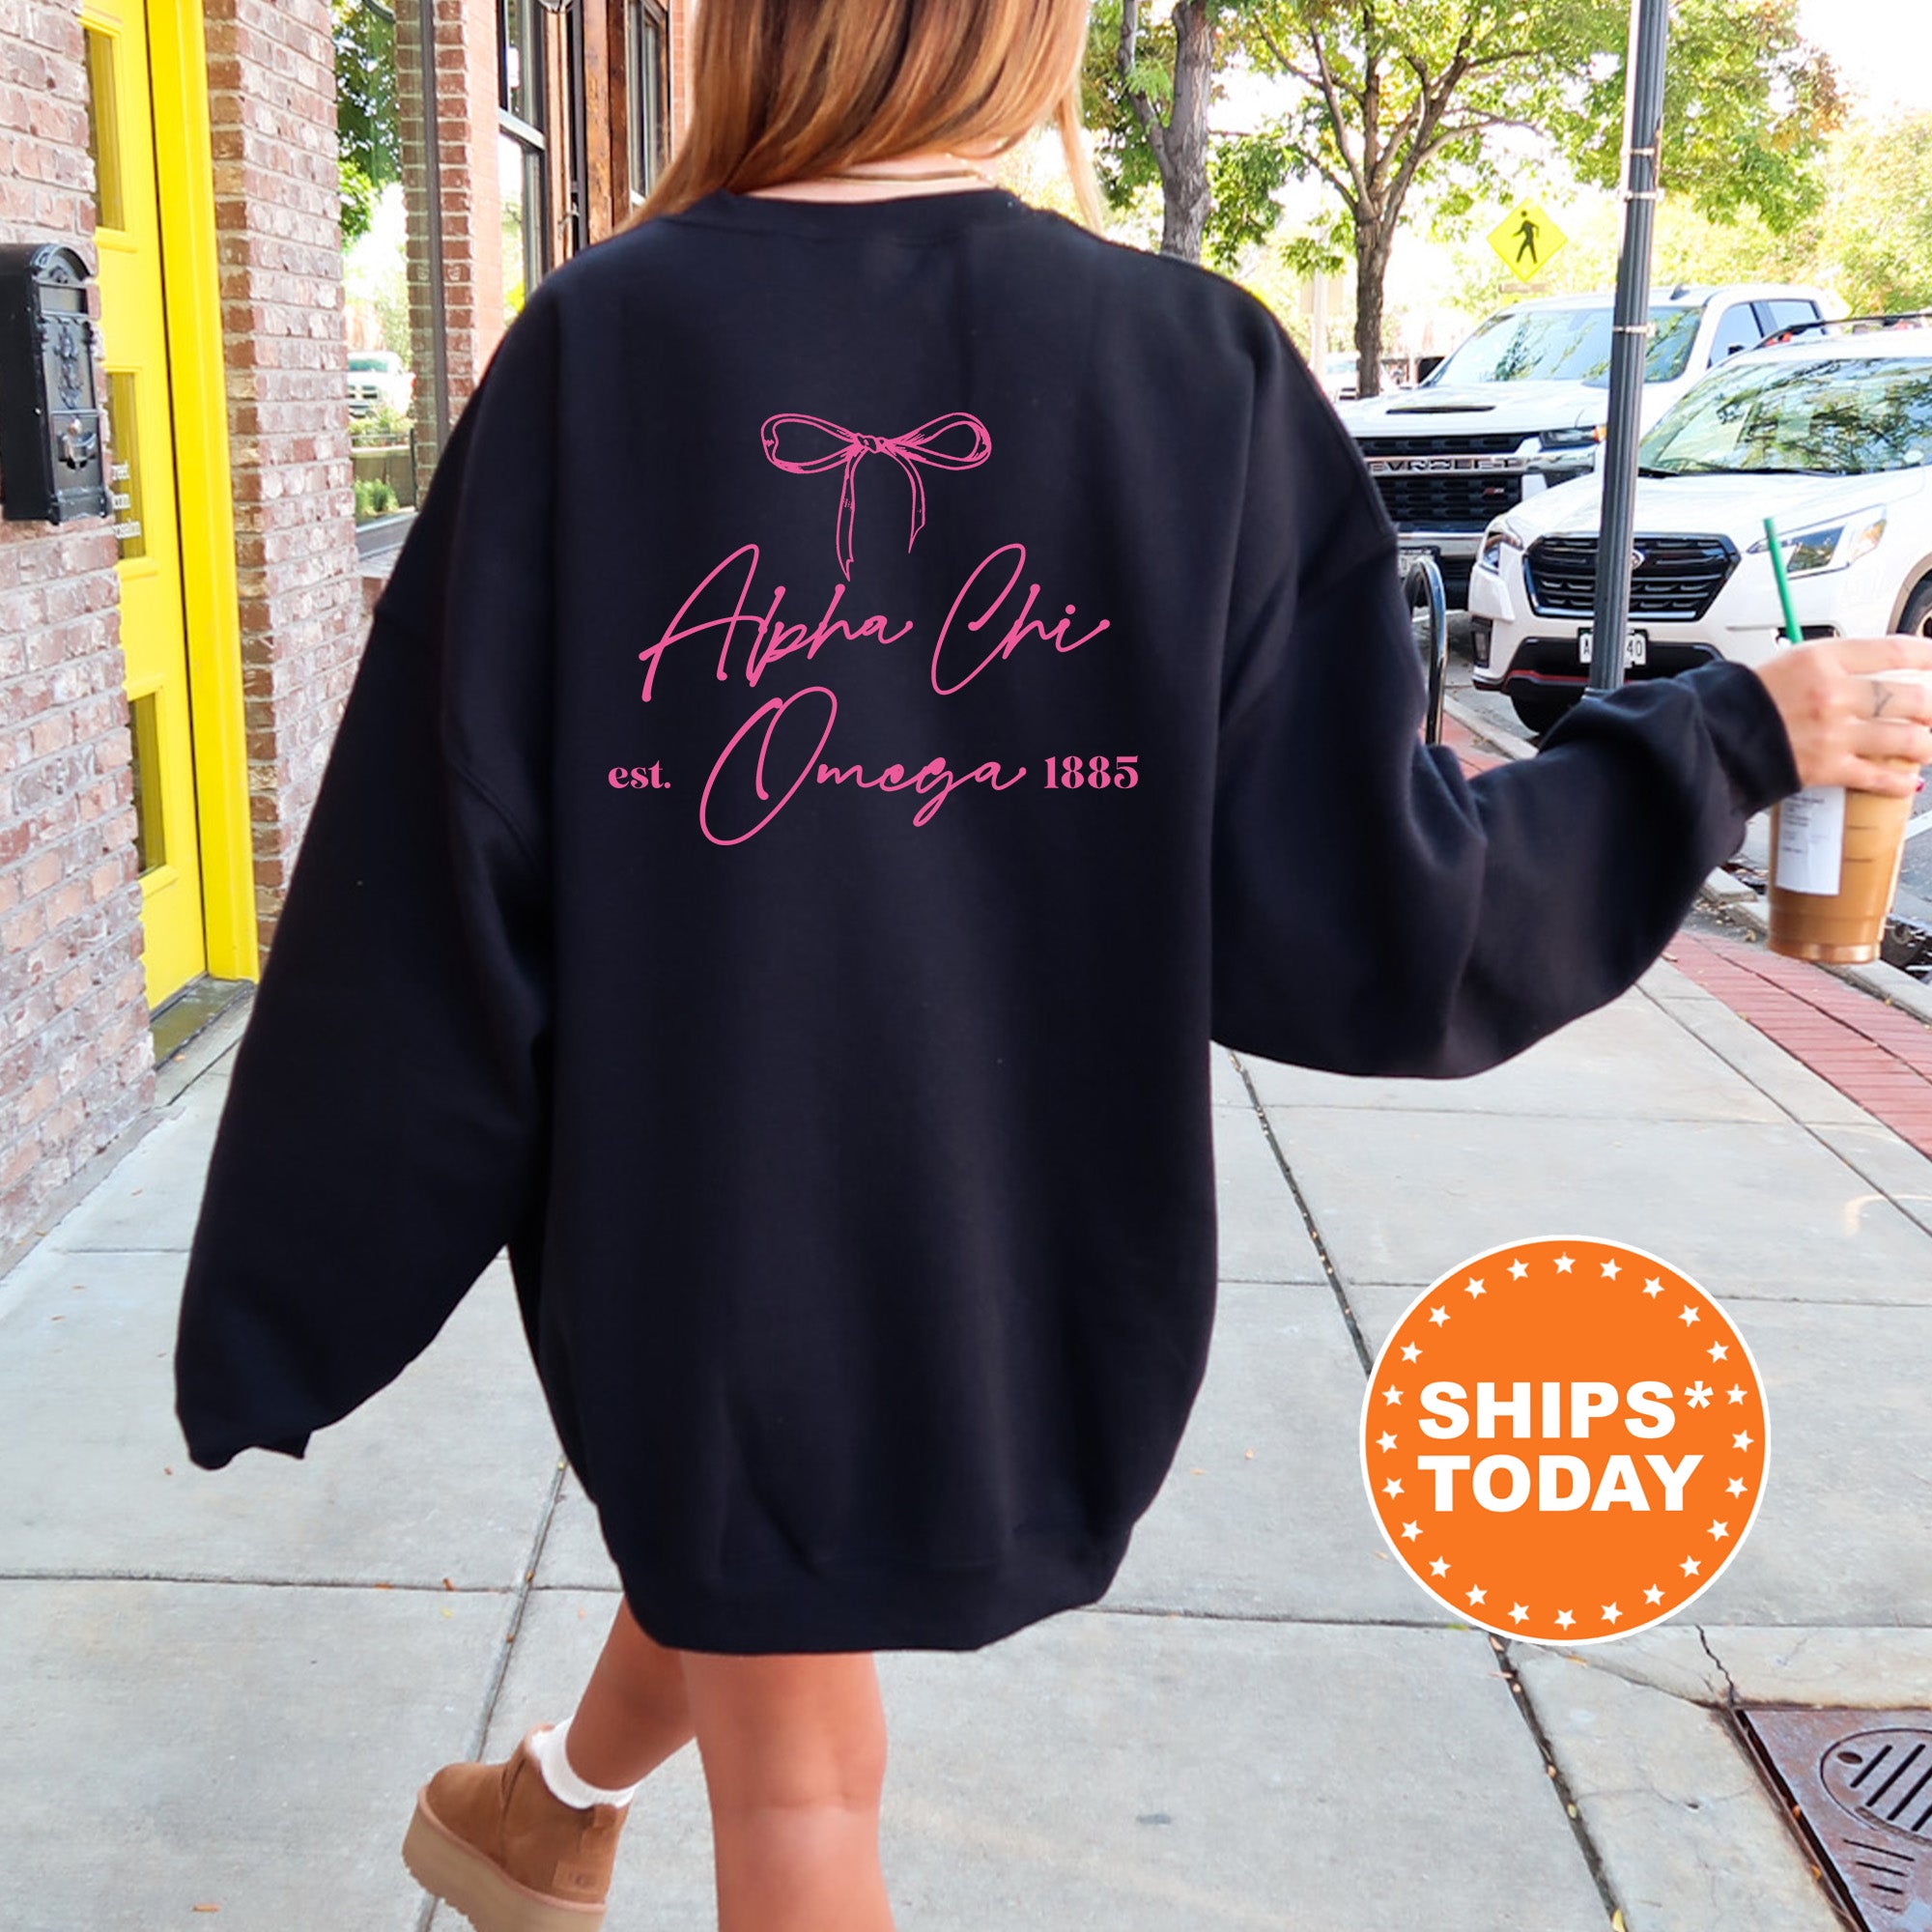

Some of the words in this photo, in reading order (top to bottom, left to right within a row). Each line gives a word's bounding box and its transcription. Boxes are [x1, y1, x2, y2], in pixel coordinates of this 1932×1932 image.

[639, 544, 913, 701] Alpha
[931, 544, 1110, 695] Chi
[609, 760, 671, 789] est.
[700, 687, 1026, 845] Omega
[1043, 755, 1138, 789] 1885
